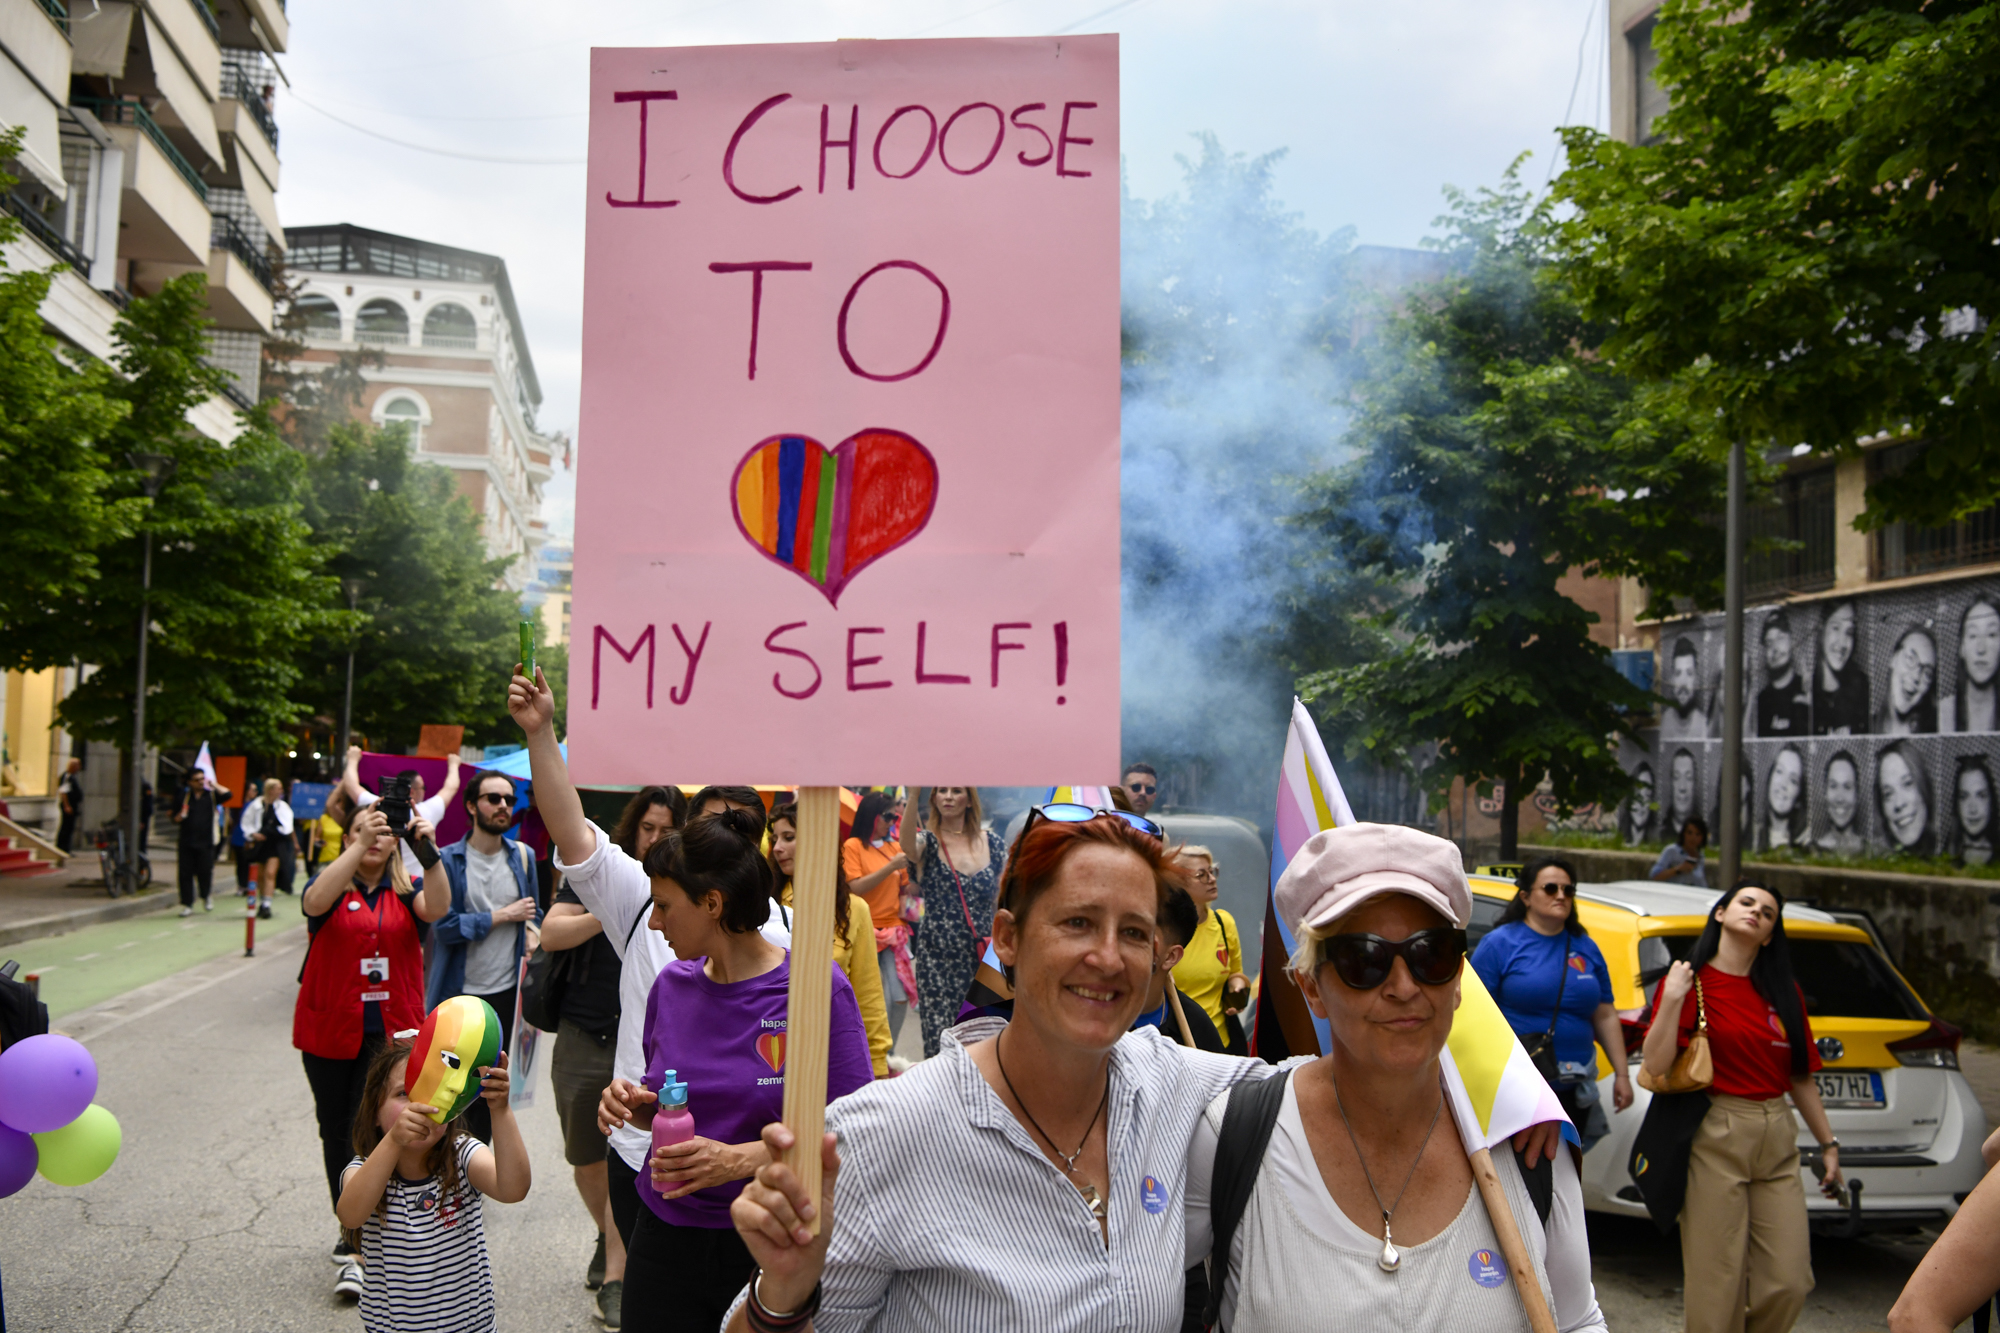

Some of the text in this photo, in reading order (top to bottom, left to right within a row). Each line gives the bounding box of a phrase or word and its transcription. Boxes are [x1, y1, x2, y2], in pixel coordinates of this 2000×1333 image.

[606, 90, 1098, 208] I CHOOSE
[707, 259, 951, 382] TO
[591, 620, 1069, 710] MY SELF!
[1495, 867, 1522, 878] TA
[761, 1019, 788, 1029] hape
[1847, 1076, 1871, 1098] HZ
